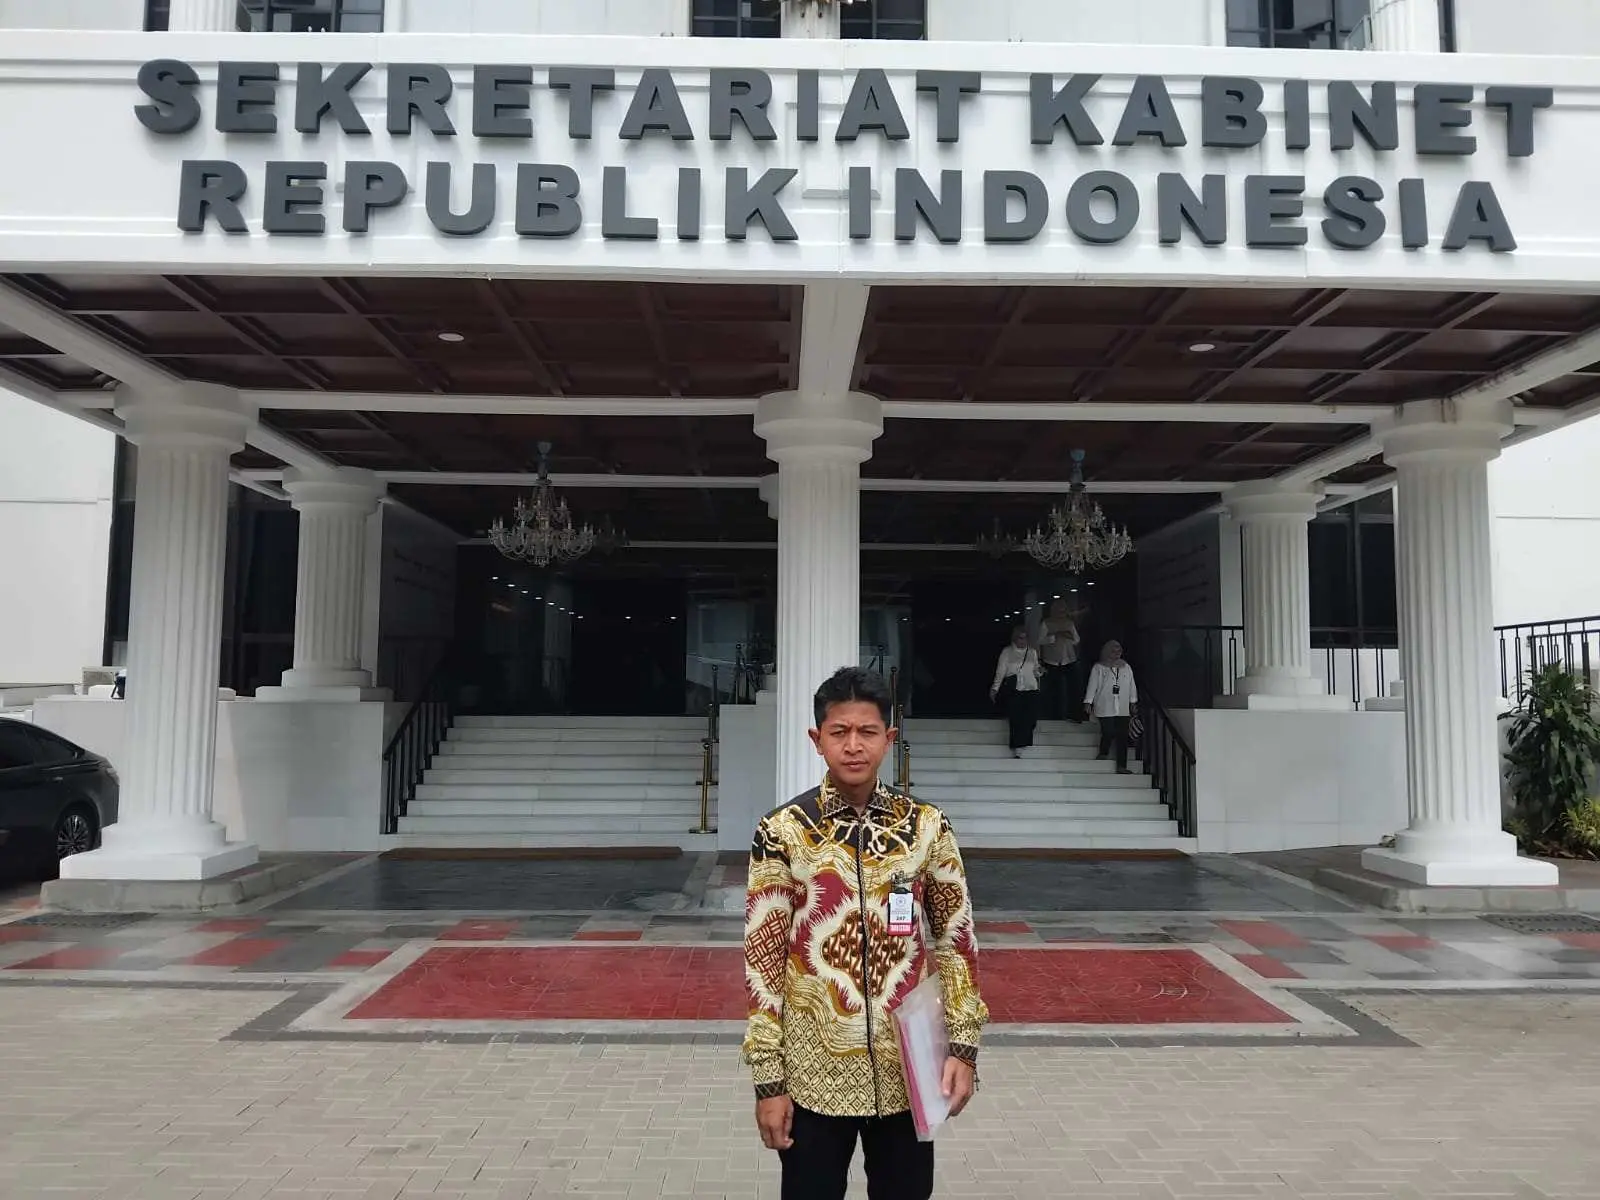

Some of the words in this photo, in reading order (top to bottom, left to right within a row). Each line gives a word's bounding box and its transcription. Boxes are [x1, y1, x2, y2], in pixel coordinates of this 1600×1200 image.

[135, 58, 981, 143] SEKRETARIAT
[1029, 72, 1553, 157] KABINET
[177, 160, 798, 241] REPUBLIK
[849, 166, 1517, 252] INDONESIA
